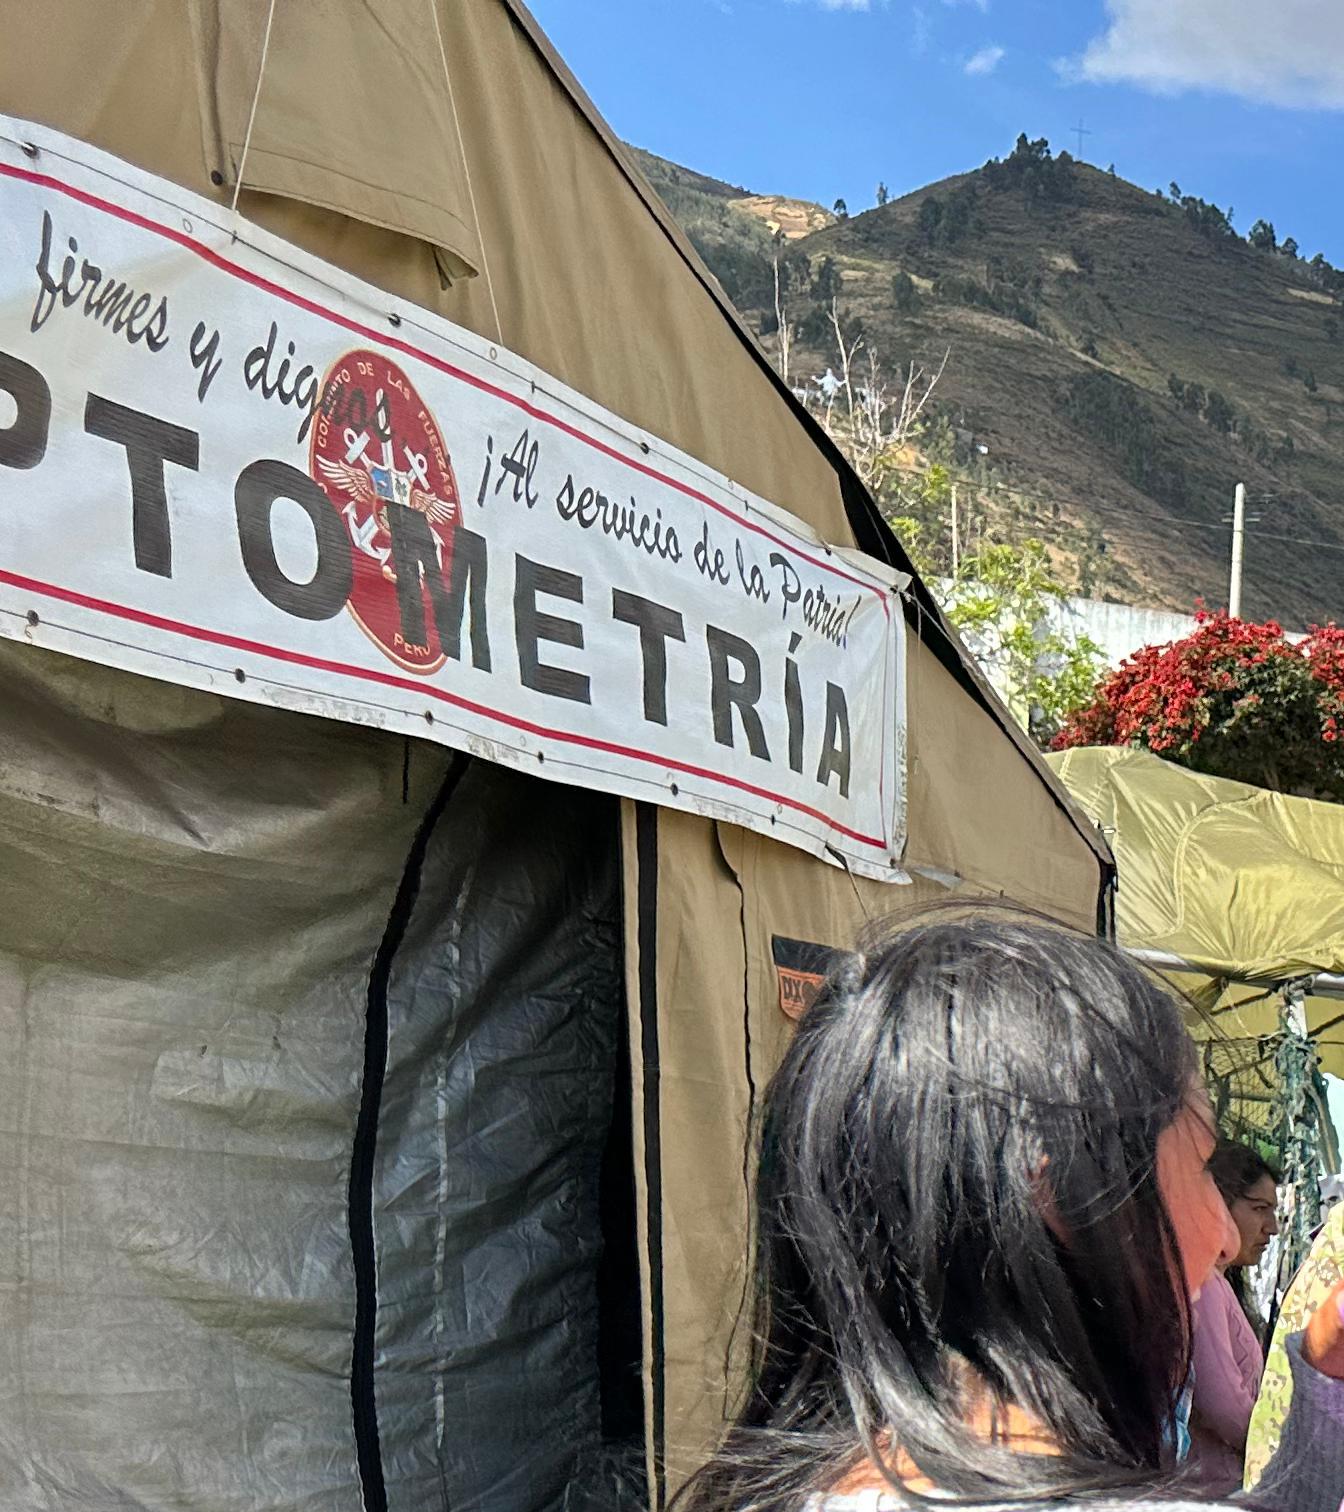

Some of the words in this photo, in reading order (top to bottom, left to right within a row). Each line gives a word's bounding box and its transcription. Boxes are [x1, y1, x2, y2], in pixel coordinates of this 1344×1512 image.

[31, 210, 169, 352] firmes
[190, 321, 223, 403] y
[555, 474, 683, 563] servicio
[694, 520, 730, 587] de
[735, 538, 770, 605] la
